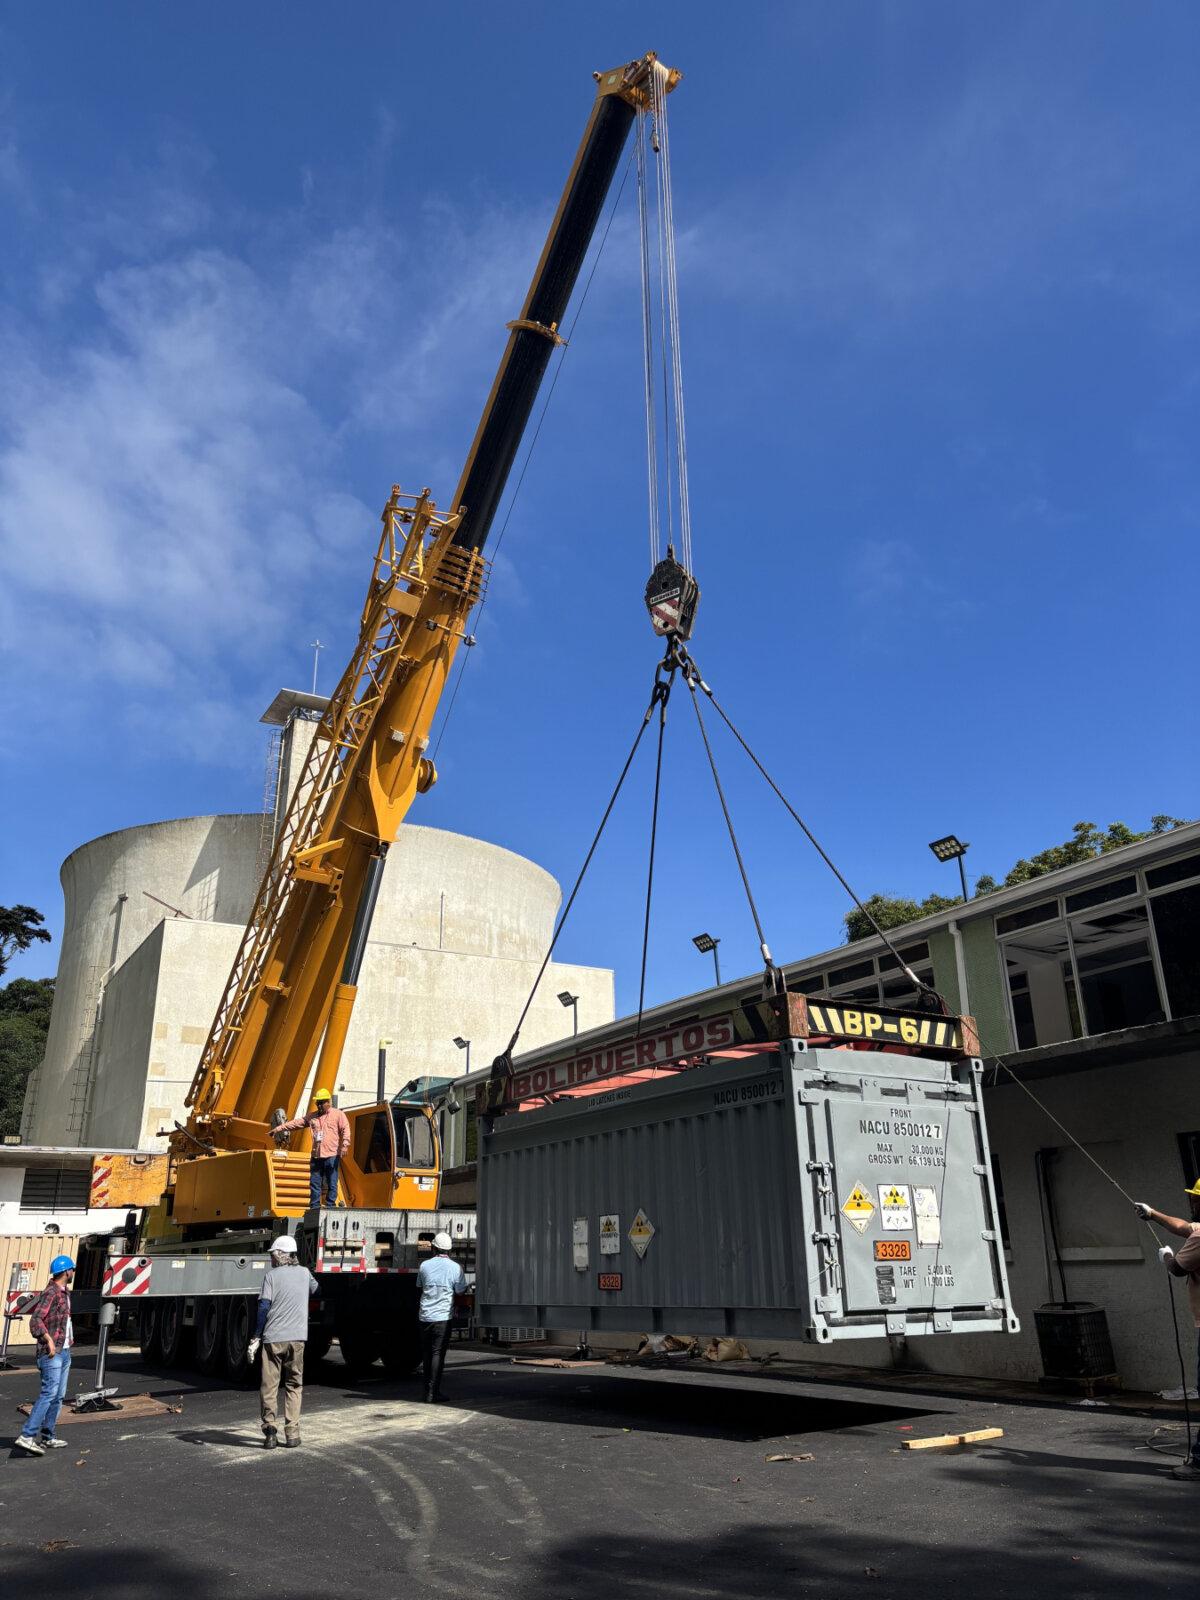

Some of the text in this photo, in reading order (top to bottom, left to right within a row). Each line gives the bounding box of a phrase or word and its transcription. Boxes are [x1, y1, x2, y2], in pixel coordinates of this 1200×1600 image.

[844, 1010, 918, 1044] BP-6
[513, 1017, 732, 1099] BOLIPUERTOS
[714, 1087, 738, 1106] NACU
[890, 1108, 911, 1119] FRONT
[859, 1120, 890, 1135] NACU
[877, 1143, 944, 1156] MAX 30.000 KG
[868, 1154, 891, 1164] GROSS
[893, 1155, 903, 1165] WT
[933, 1158, 945, 1167] LBS
[881, 1243, 907, 1257] 3328
[899, 1266, 916, 1276] TARE
[945, 1265, 952, 1275] KG
[601, 1276, 619, 1288] 3328
[903, 1279, 914, 1288] WT
[944, 1276, 954, 1286] LBS
